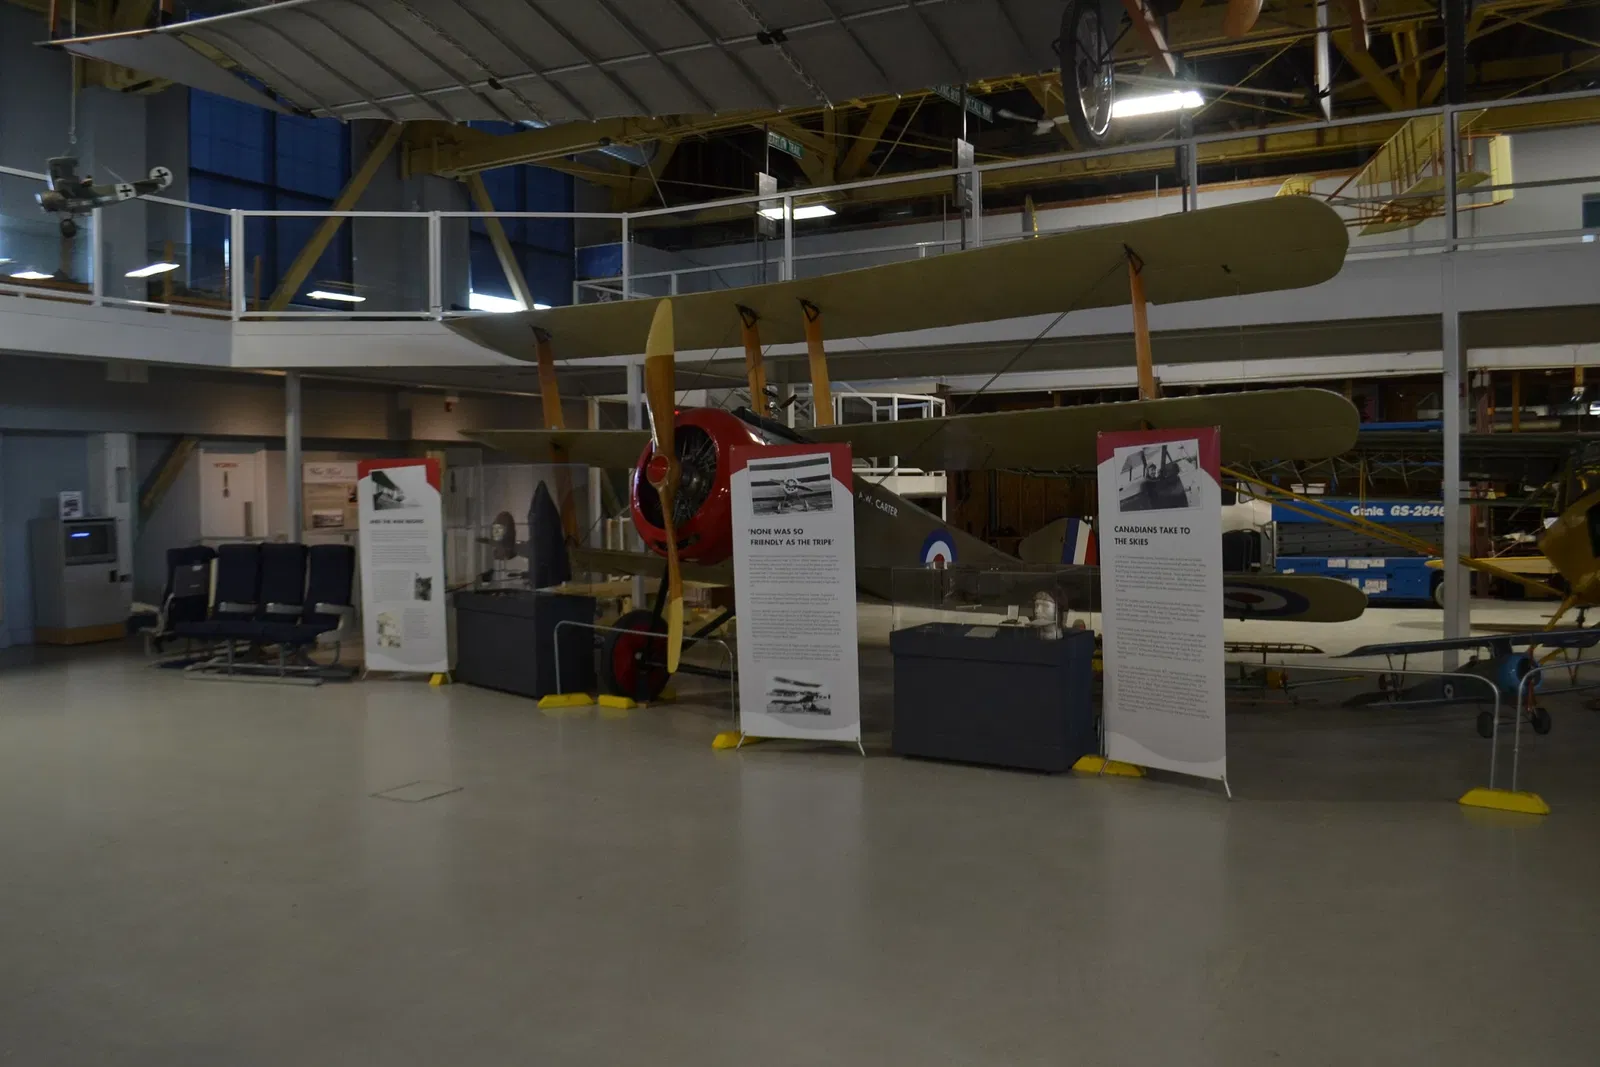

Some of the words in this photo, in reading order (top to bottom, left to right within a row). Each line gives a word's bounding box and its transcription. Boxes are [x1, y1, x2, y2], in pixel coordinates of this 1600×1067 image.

[875, 499, 899, 517] CARTER
[1350, 505, 1384, 516] Genie
[1114, 526, 1157, 534] CANADIANS
[1159, 526, 1178, 534] TAKE
[750, 538, 783, 546] FRIENDLY
[786, 538, 795, 546] AS
[1114, 537, 1127, 545] THE
[1129, 538, 1149, 546] SKIES
